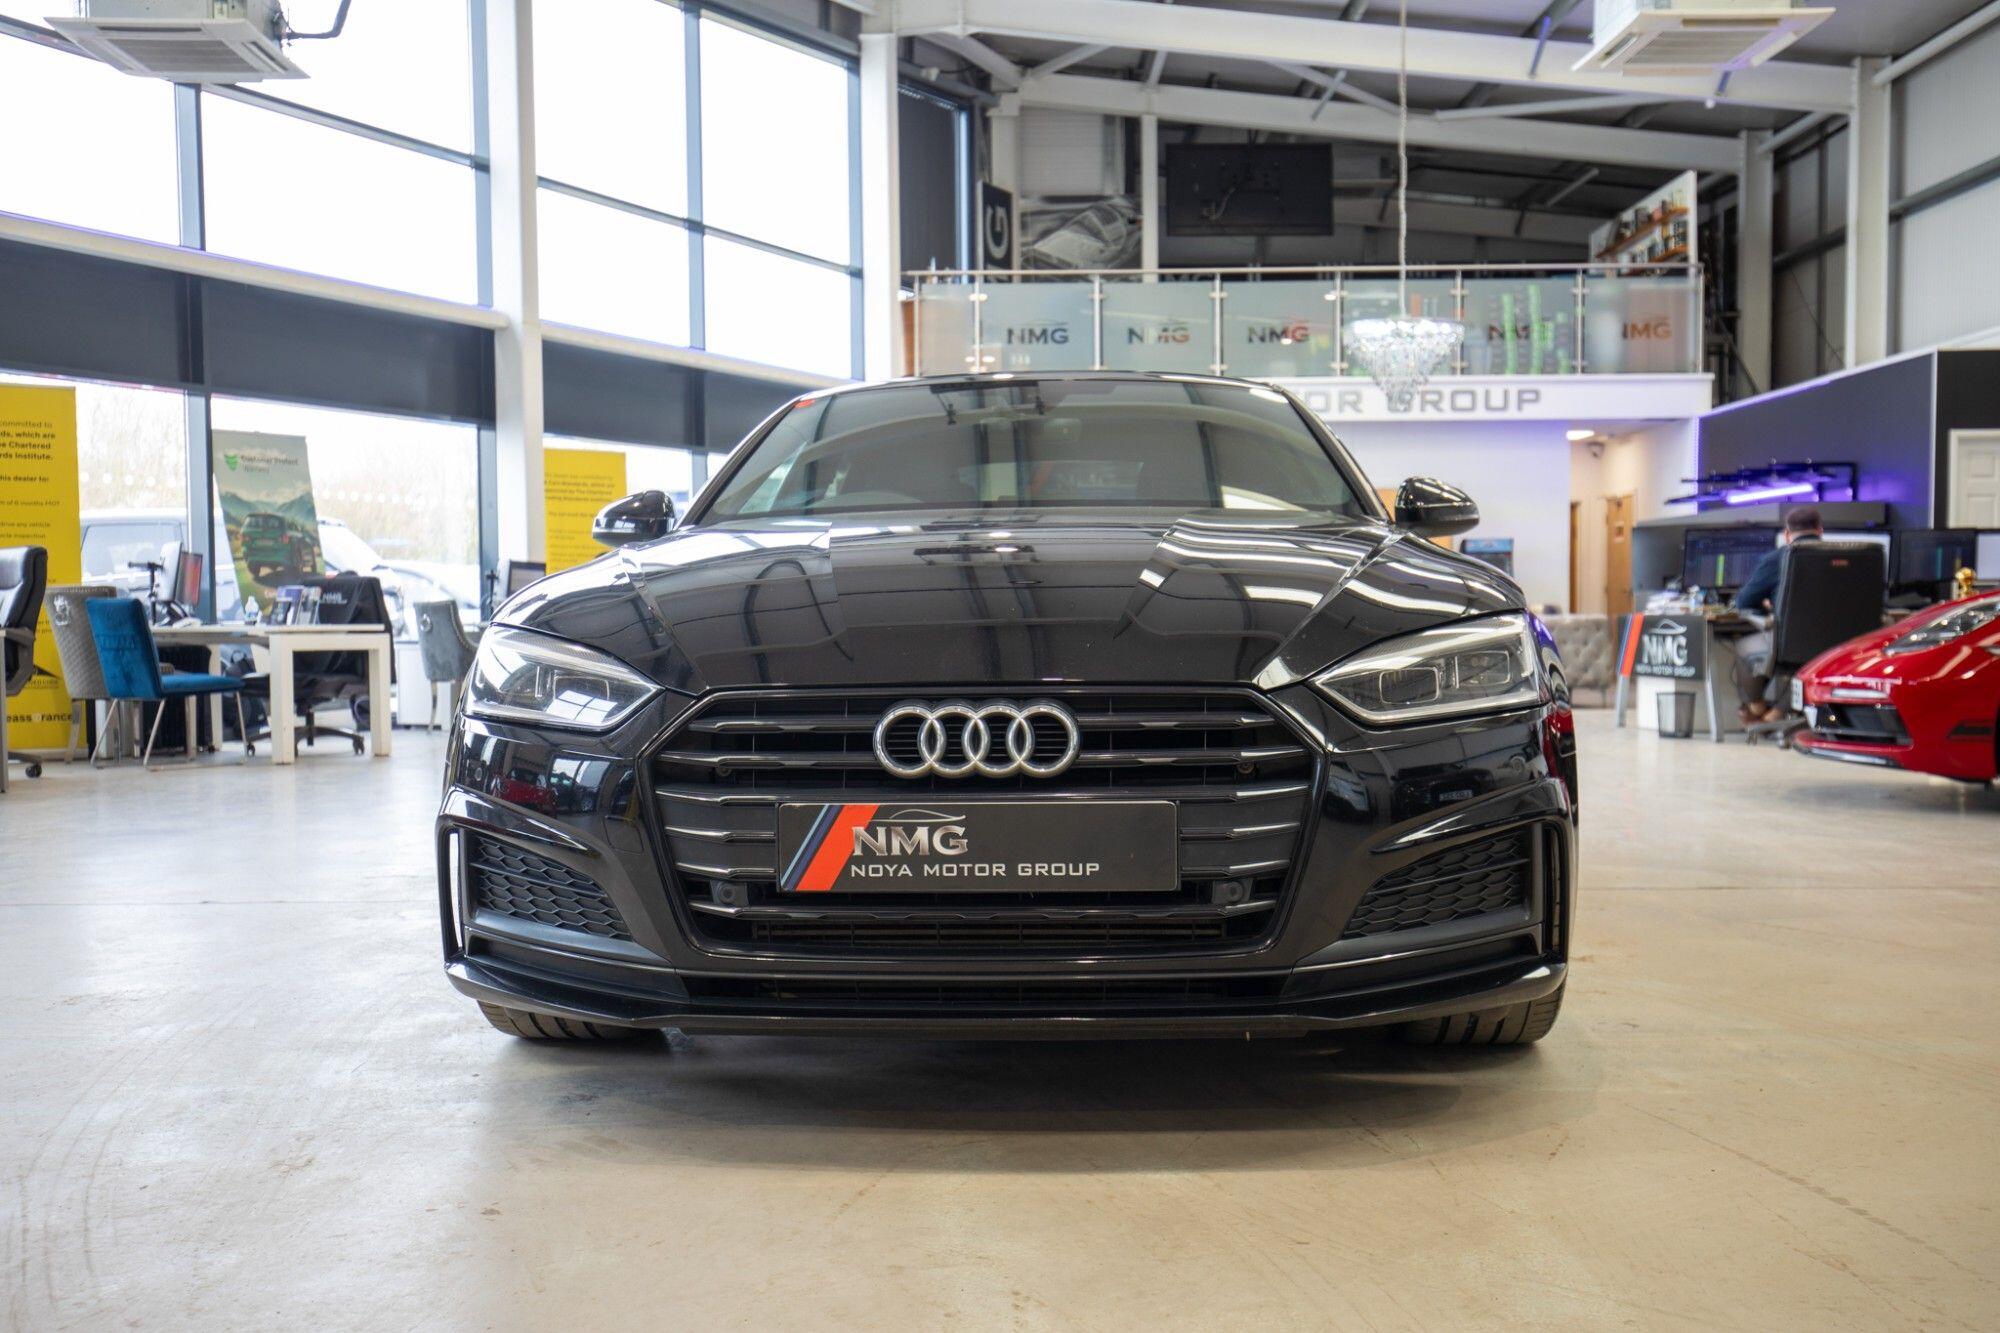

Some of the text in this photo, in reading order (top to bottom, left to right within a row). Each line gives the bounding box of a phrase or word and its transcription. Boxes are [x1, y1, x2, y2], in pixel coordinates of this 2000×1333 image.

[1007, 328, 1069, 344] NMG
[1248, 326, 1310, 343] NMG
[1305, 389, 1541, 413] OR GROUP
[9, 441, 51, 449] Chartered
[1642, 633, 1688, 666] NMG
[850, 825, 969, 857] NMG
[850, 862, 1100, 877] NOYA MOTOR GROUP
